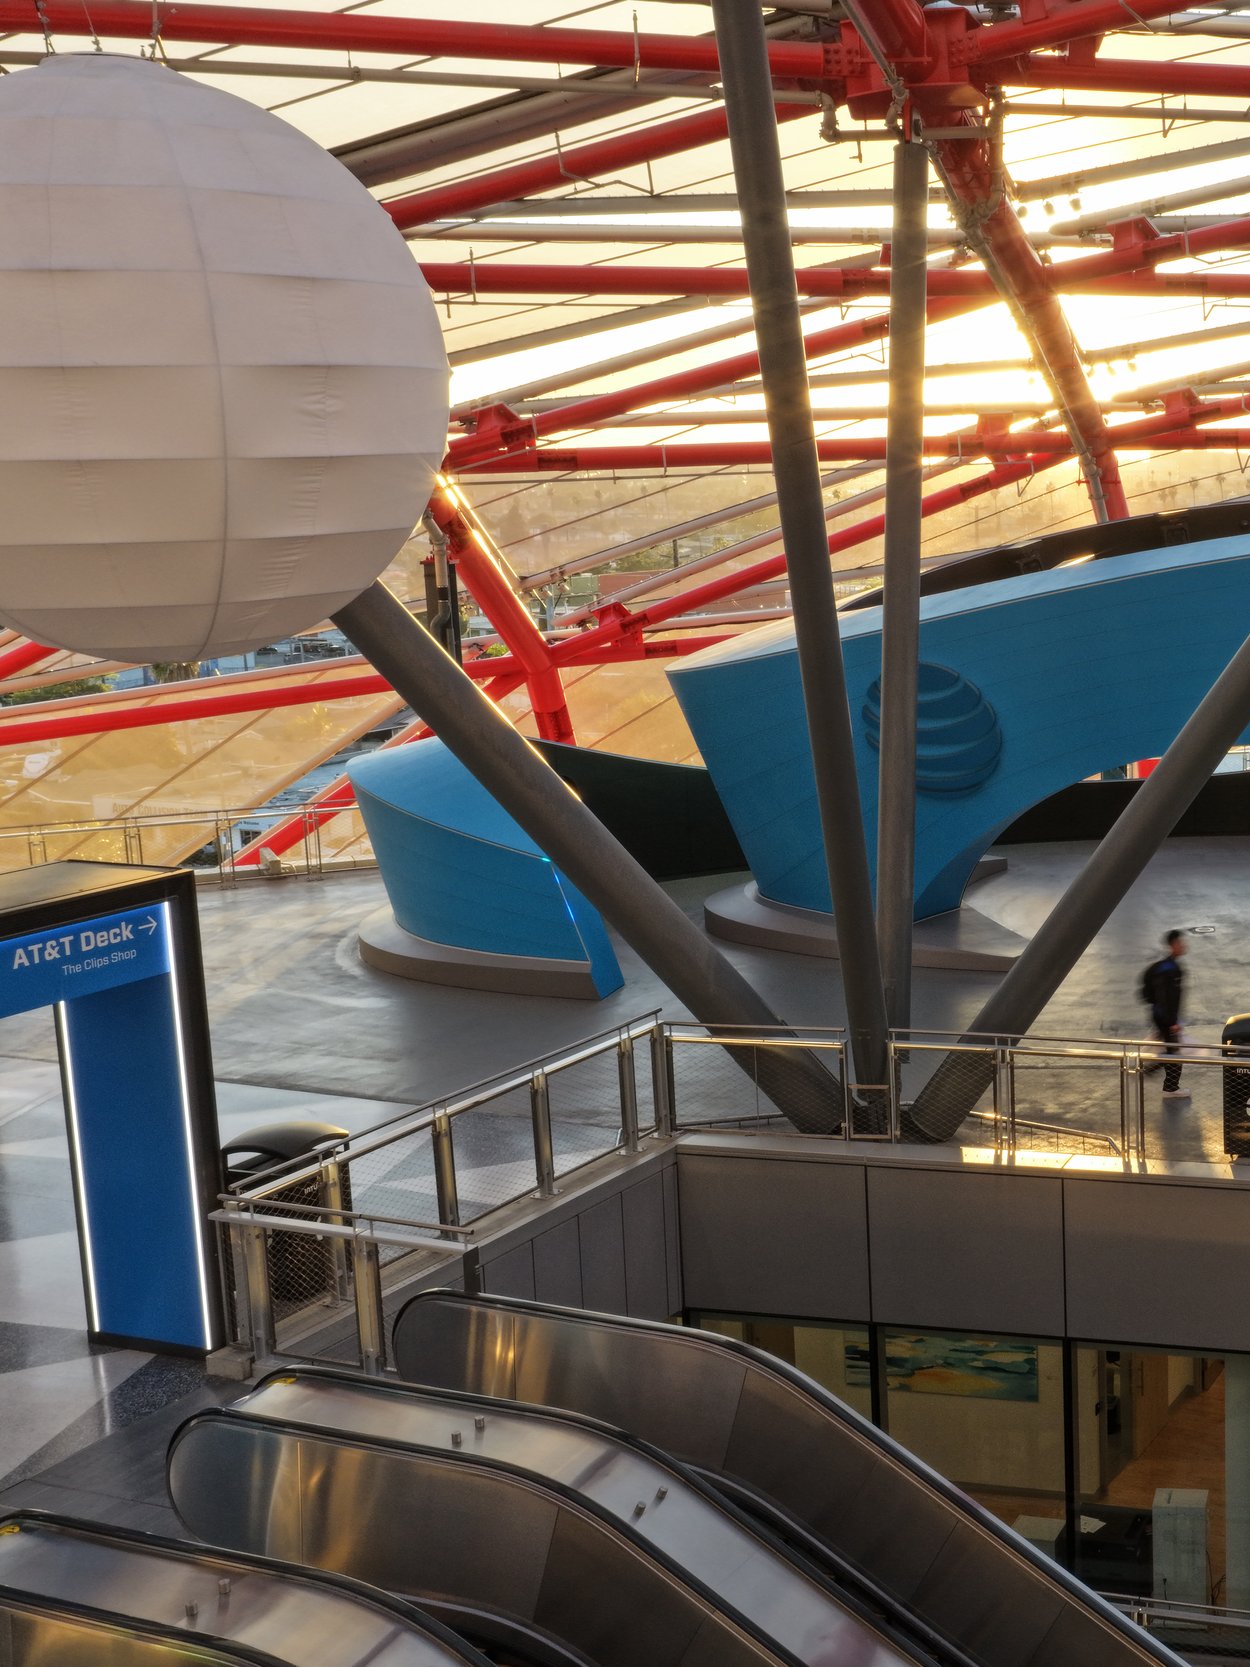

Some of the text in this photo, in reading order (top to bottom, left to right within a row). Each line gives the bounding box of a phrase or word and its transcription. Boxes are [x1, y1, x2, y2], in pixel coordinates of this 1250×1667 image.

[13, 921, 134, 970] AT&T Deck
[62, 949, 137, 976] The Clips Shop
